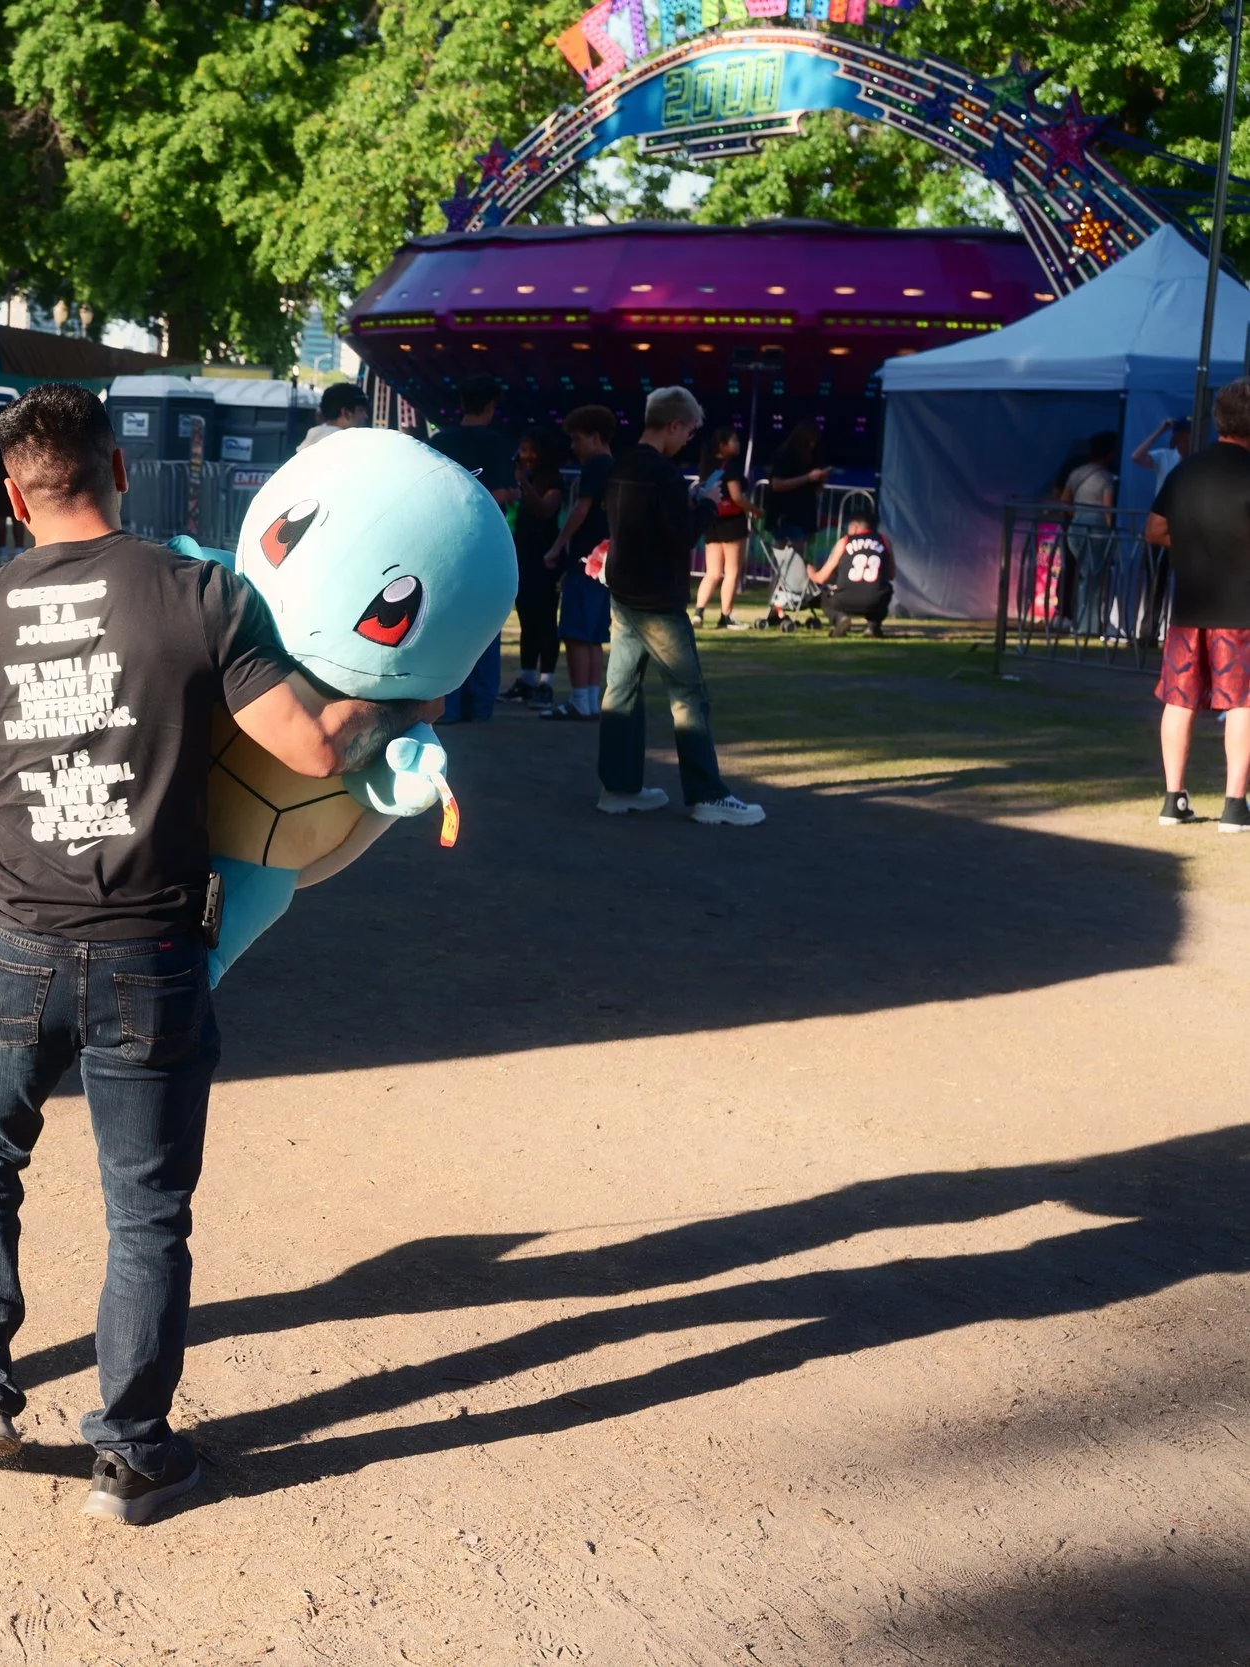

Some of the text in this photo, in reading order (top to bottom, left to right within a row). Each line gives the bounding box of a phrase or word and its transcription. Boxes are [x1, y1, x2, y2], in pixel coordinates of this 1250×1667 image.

[662, 50, 784, 127] 2000
[848, 554, 881, 582] 33
[7, 580, 107, 608] GREATNESS
[40, 604, 76, 624] IS A
[16, 617, 105, 645] JOURNEY.
[4, 653, 121, 684] WE WILL ALL
[18, 673, 113, 702] ARRIVE AT
[21, 692, 113, 720] DIFFERENT
[4, 706, 137, 740] DESTINATIONS.
[52, 749, 90, 771] IT IS
[18, 762, 135, 791] THE ARRIVAL
[41, 784, 109, 806] THAT IS
[28, 798, 128, 823] THE PROOF
[31, 814, 136, 842] OF SUCCESS.
